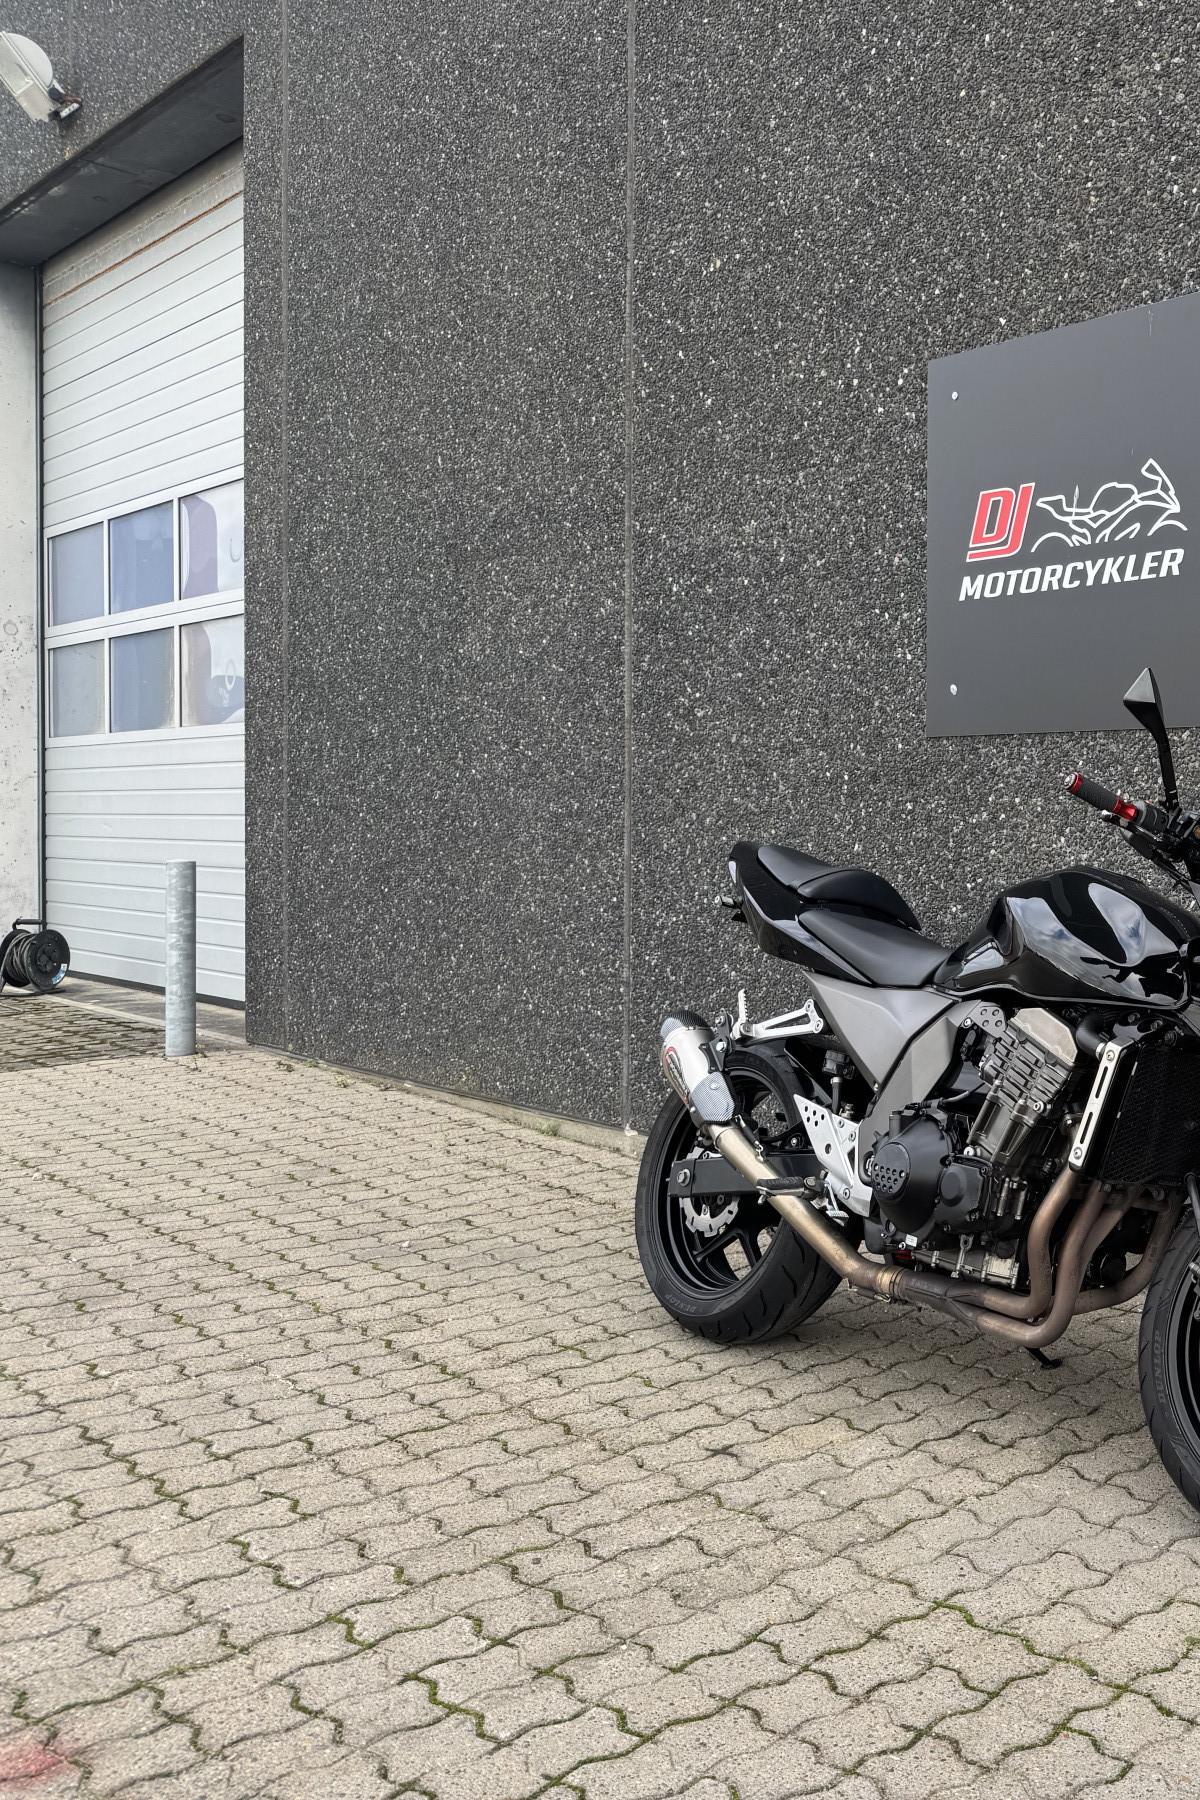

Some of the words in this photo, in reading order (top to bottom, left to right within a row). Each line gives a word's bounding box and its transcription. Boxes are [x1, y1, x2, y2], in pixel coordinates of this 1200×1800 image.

[966, 482, 1035, 562] DJ
[959, 548, 1185, 601] MOTORCYKLER
[1153, 1329, 1167, 1404] DUNLOP
